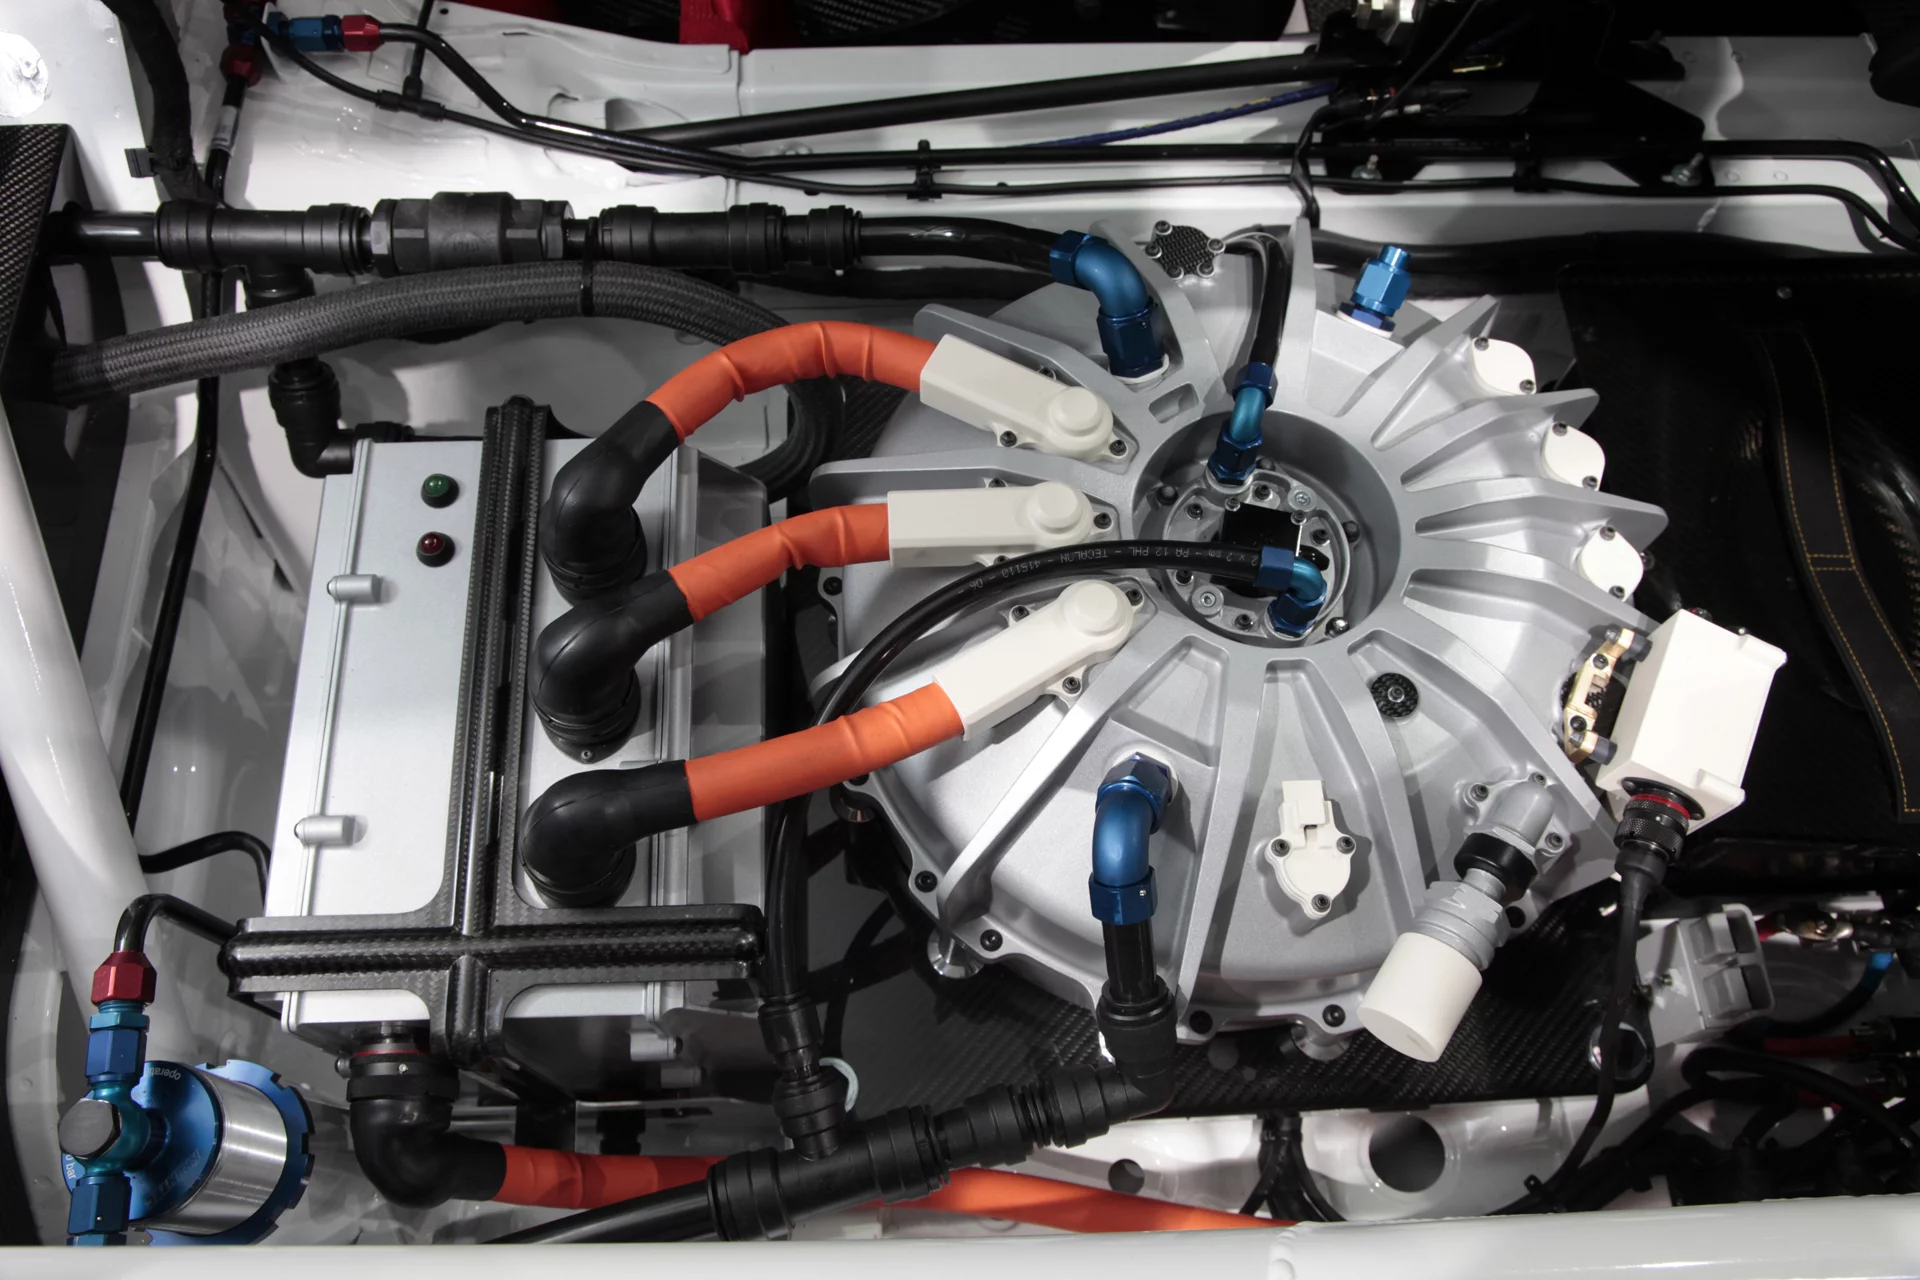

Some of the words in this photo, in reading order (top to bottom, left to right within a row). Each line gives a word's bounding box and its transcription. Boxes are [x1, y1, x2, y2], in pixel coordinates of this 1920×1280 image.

[1128, 546, 1149, 557] PHL
[1155, 546, 1169, 557] 12
[1175, 547, 1190, 558] PA
[1226, 552, 1233, 562] 2
[144, 1065, 181, 1080] operati
[65, 1162, 77, 1180] bar
